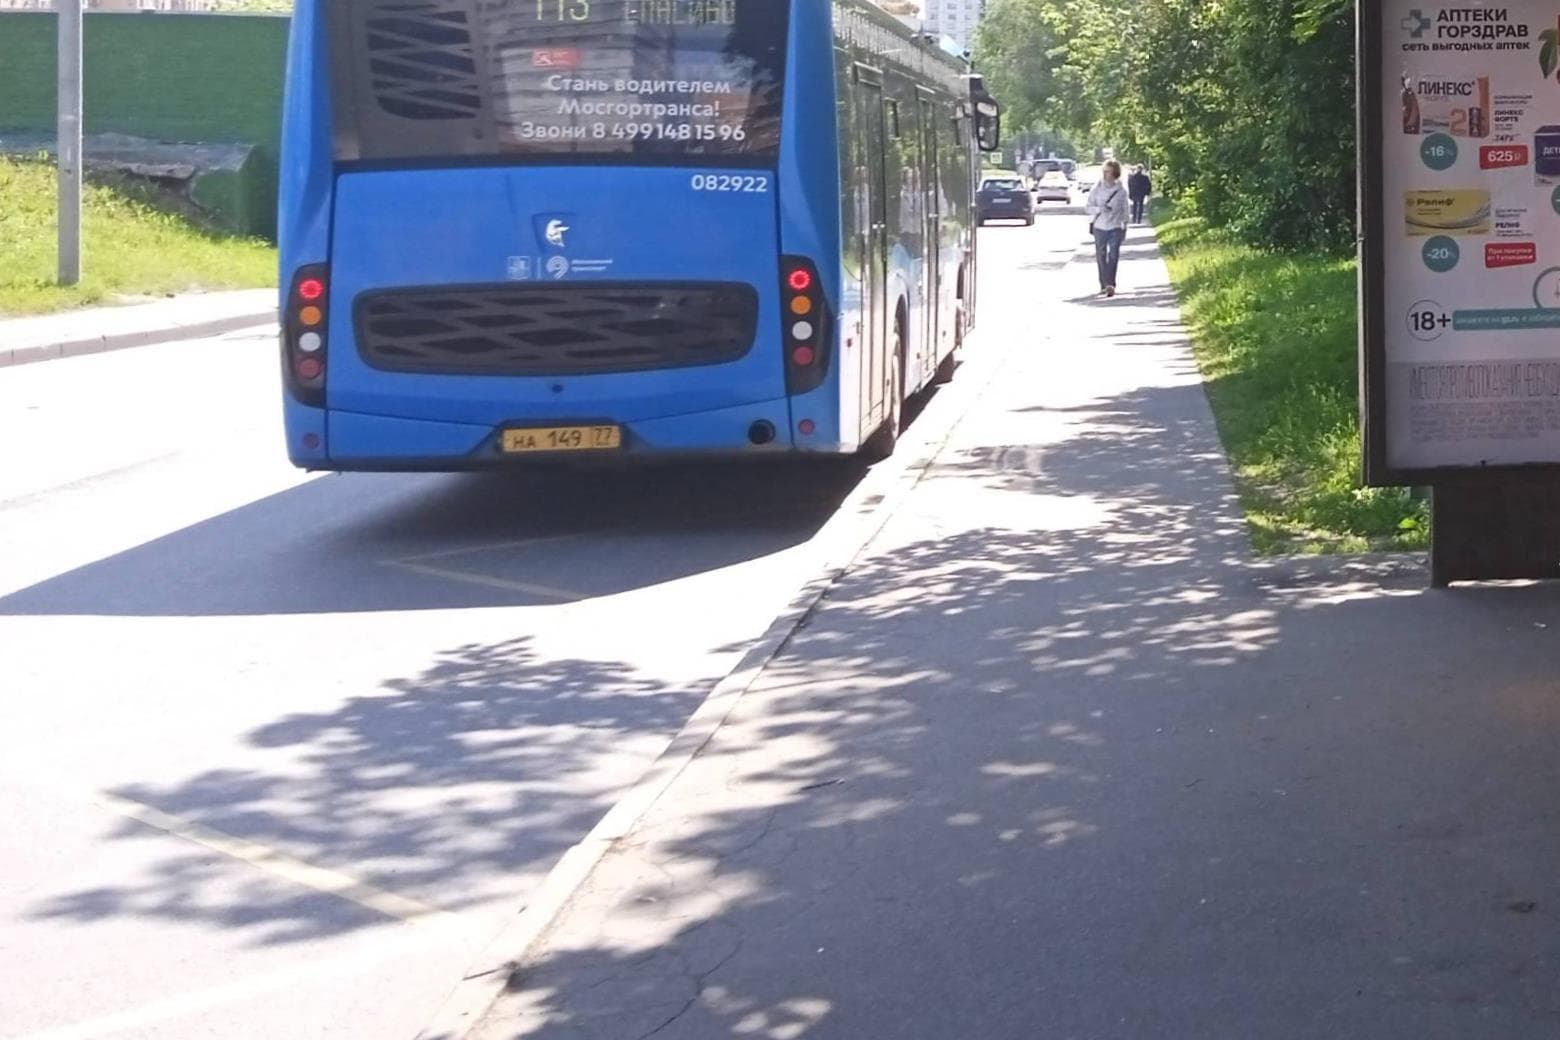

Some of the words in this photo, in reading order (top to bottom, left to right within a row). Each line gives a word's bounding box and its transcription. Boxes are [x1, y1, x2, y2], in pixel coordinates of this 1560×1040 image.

[1437, 8, 1508, 22] АПТЕКИ
[1437, 24, 1529, 39] ГОРЗДРАВ
[1402, 43, 1429, 52] сеть
[1432, 42, 1493, 52] выгодных
[1495, 41, 1530, 51] аптек
[547, 74, 609, 92] Стань
[615, 78, 731, 96] водителем
[1417, 81, 1473, 97] ЛИНЕКС
[557, 99, 720, 119] Мосгортранса!
[521, 121, 586, 139] Звони
[592, 122, 606, 139] 8
[612, 123, 653, 140] 499
[656, 123, 691, 140] 148
[694, 124, 716, 140] 15
[718, 124, 746, 141] 96
[691, 174, 768, 192] 082922
[1411, 311, 1451, 331] 18+
[513, 435, 536, 448] НА
[547, 430, 582, 447] 149
[594, 427, 613, 440] 77
